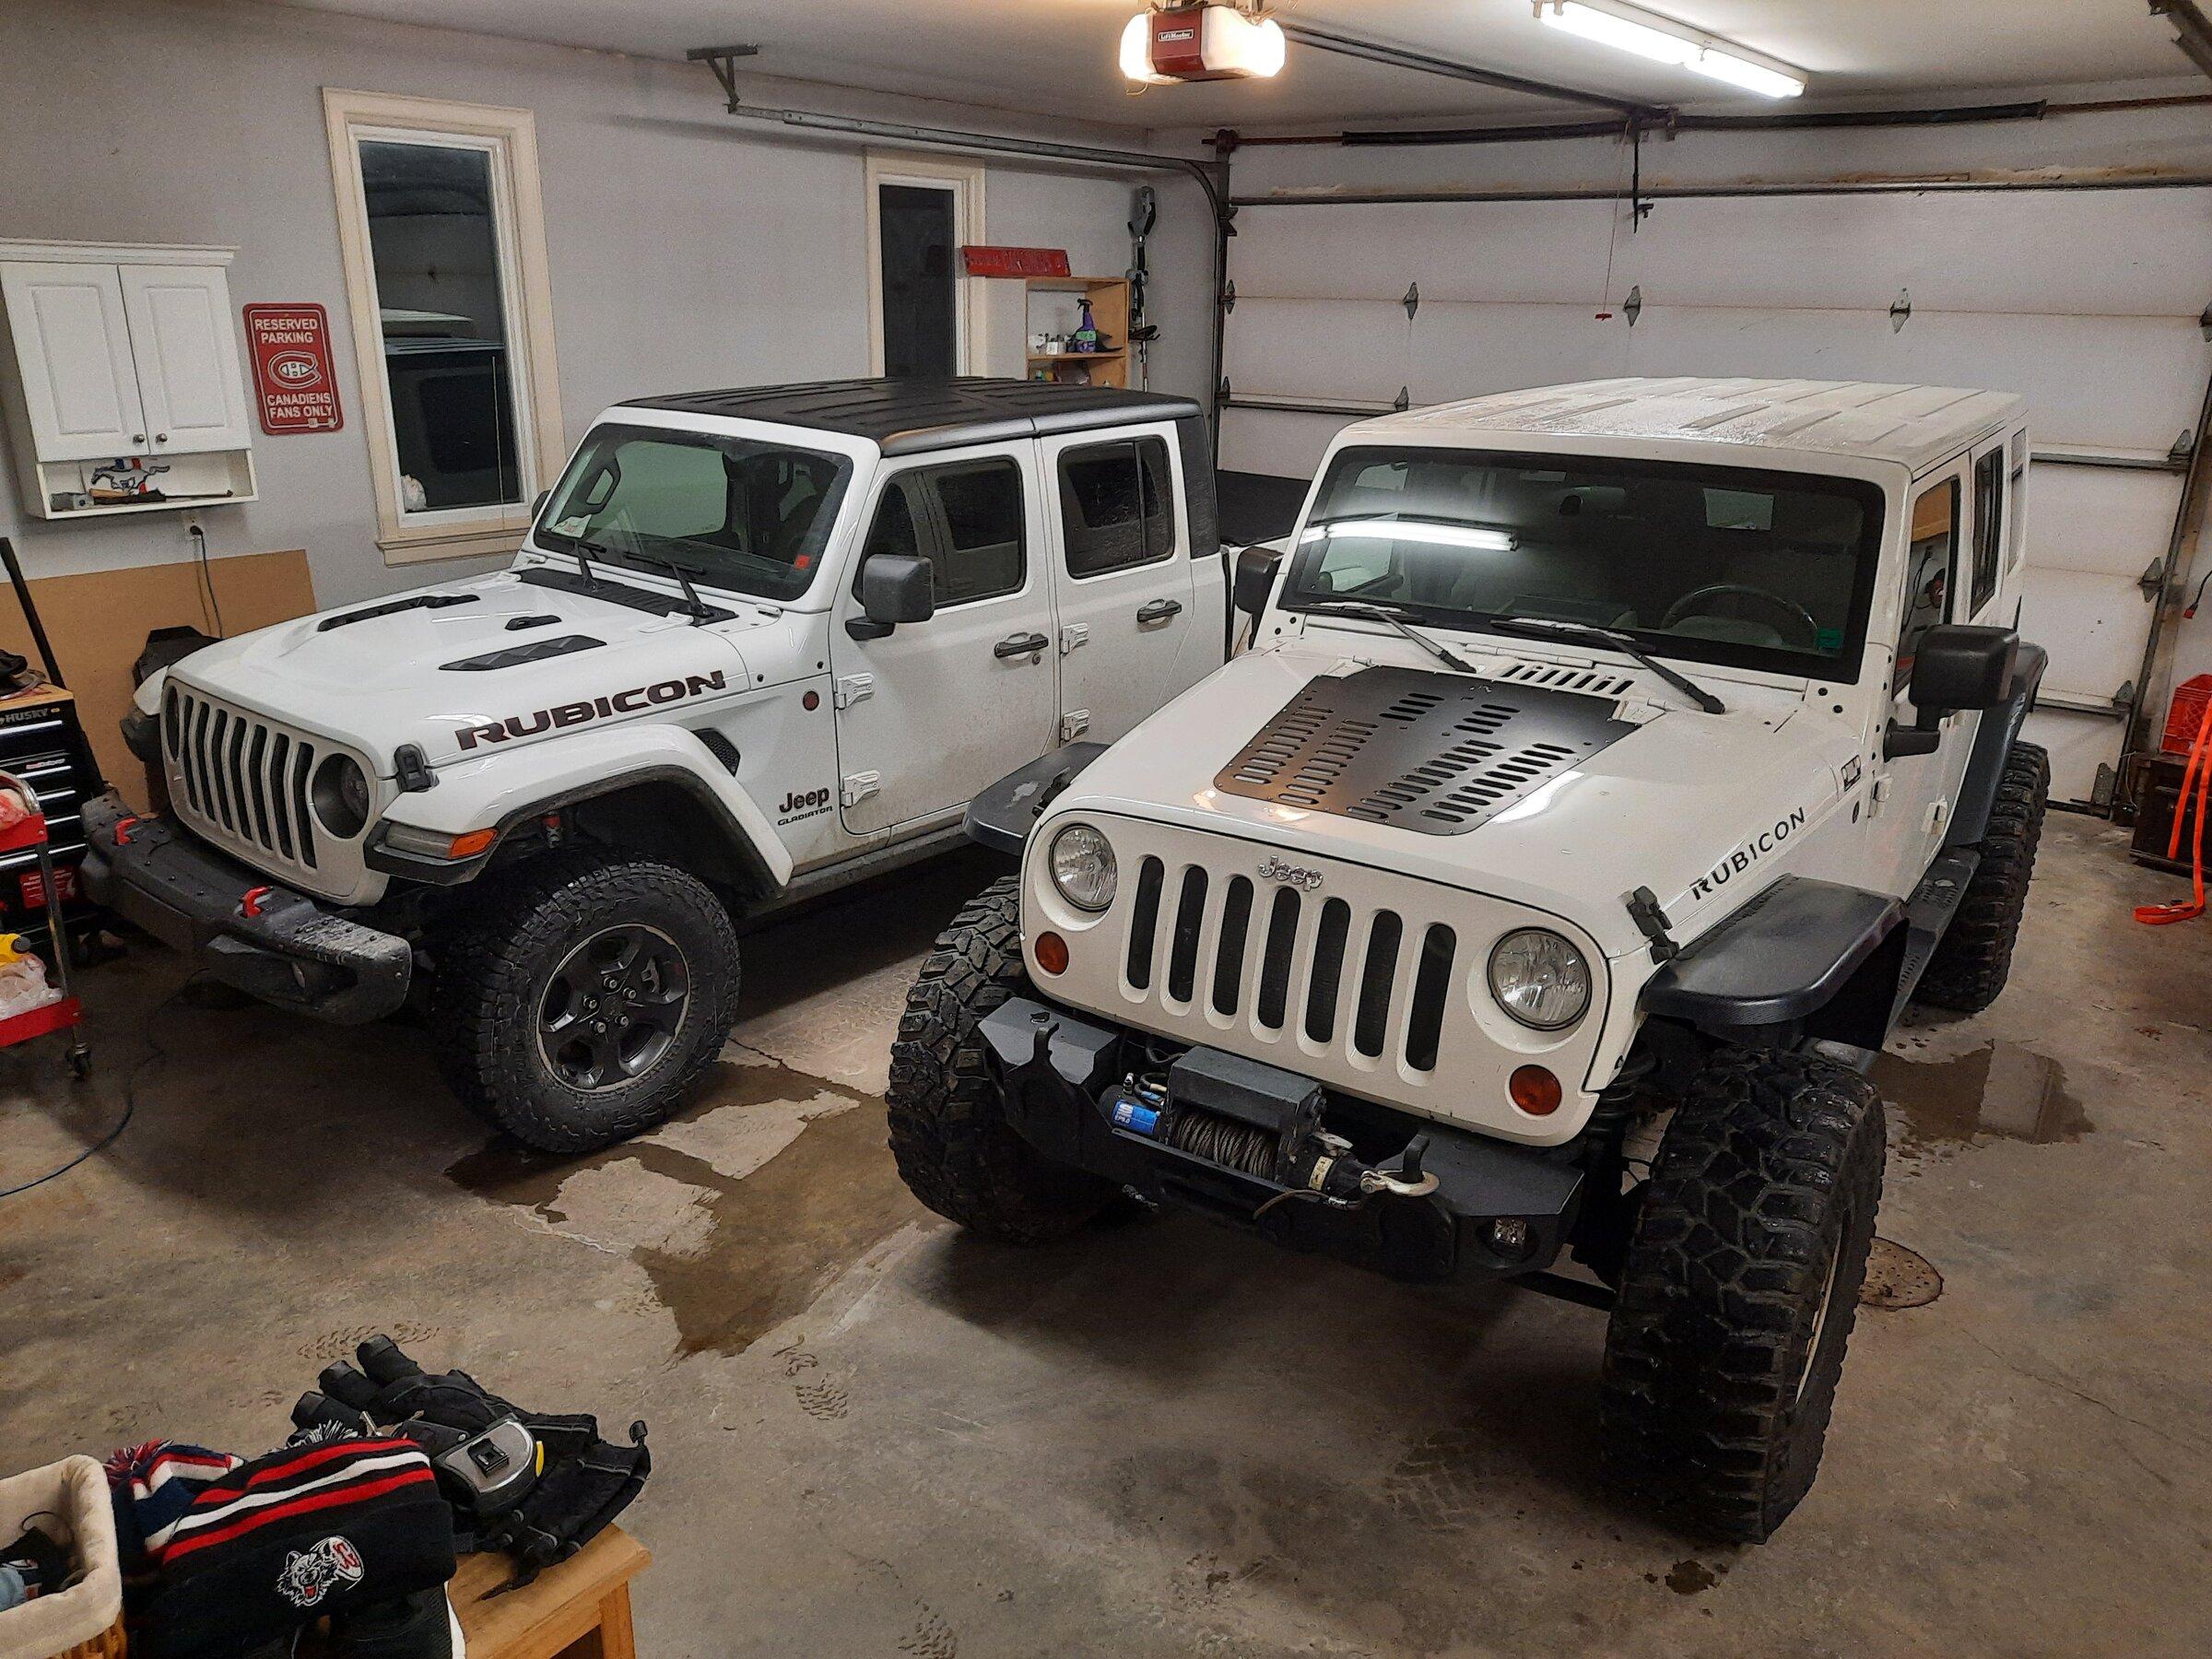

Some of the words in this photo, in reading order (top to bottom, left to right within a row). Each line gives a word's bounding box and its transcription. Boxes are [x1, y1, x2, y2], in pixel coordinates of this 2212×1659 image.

[254, 319, 318, 331] RESERVED
[261, 332, 314, 344] PARKING
[266, 392, 332, 406] CANADIENS
[269, 406, 301, 419] FANS
[302, 405, 333, 418] ONLY
[5, 708, 49, 723] HUSKY
[455, 670, 726, 751] RUBICON
[779, 787, 830, 813] Jeep
[777, 806, 833, 826] GLADIATOR
[1689, 806, 1806, 900] RUBICON
[1258, 854, 1324, 892] Jeep
